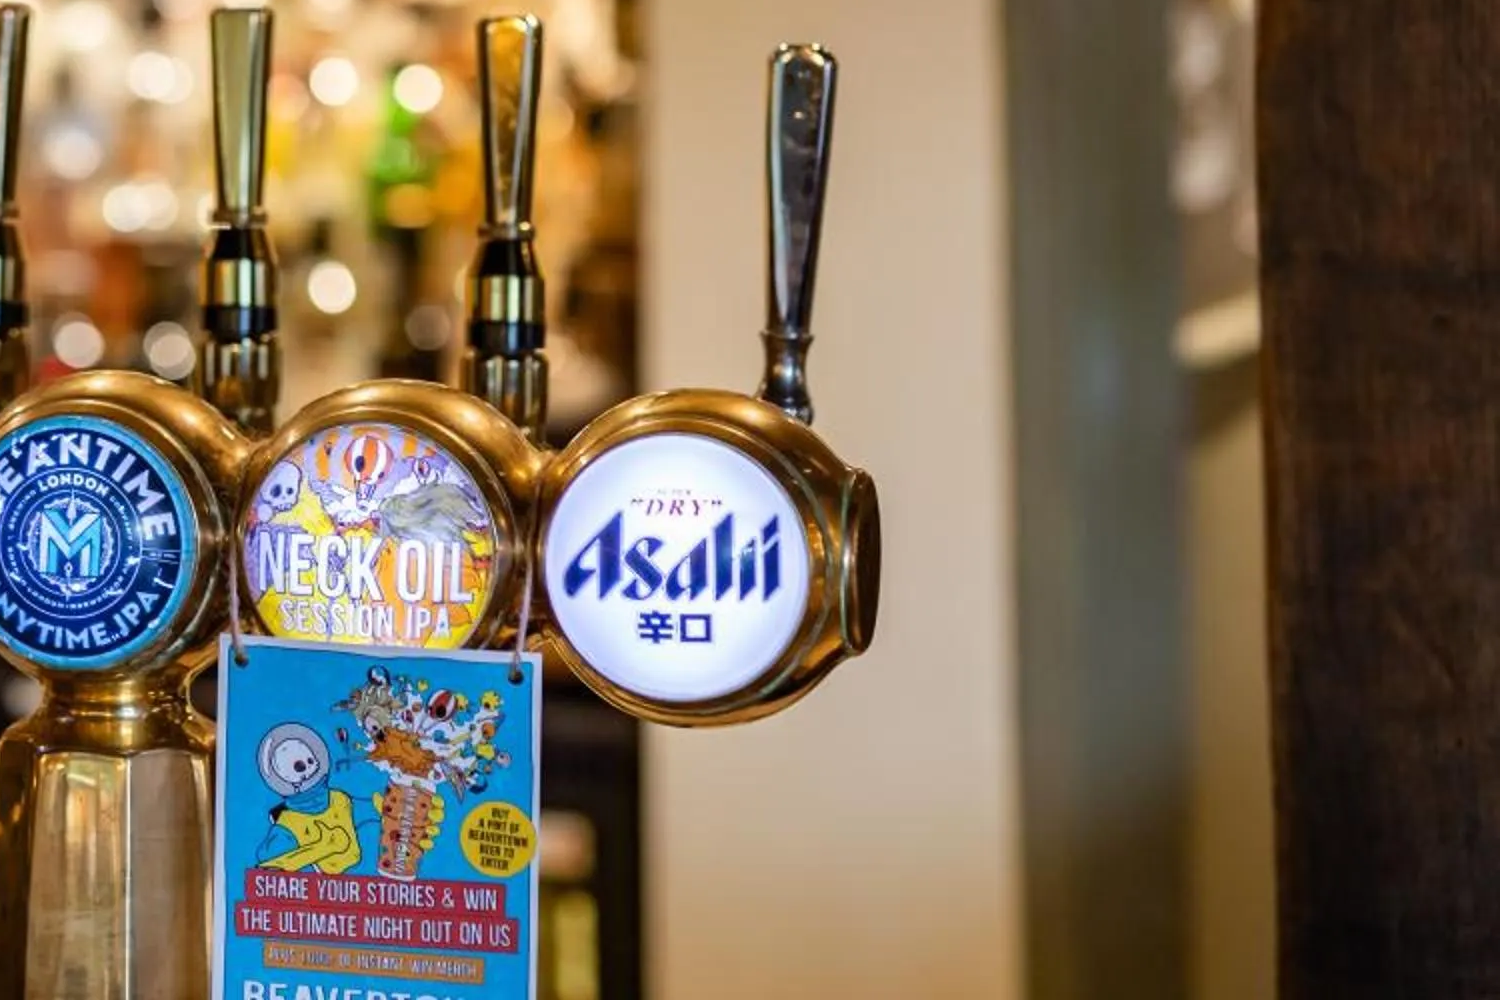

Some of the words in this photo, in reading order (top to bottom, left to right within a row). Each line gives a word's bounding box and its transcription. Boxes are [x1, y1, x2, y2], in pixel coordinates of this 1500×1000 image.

[37, 472, 109, 497] LONDON
[258, 529, 385, 602] NECK
[397, 537, 474, 604] OIL
[563, 509, 782, 603] Asahi
[280, 599, 394, 639] SESSION
[405, 606, 451, 641] IPA
[637, 610, 714, 645] 辛口
[254, 875, 309, 900] SHARE
[317, 878, 361, 903] YOUR
[367, 882, 435, 908] STORIES
[441, 887, 455, 907] &
[463, 887, 497, 911] WIN
[241, 907, 272, 932] THE
[278, 911, 357, 938] ULTIMATE
[363, 915, 413, 941] NIGHT
[420, 919, 453, 943] OUT
[459, 922, 483, 946] ON
[489, 924, 511, 948] US
